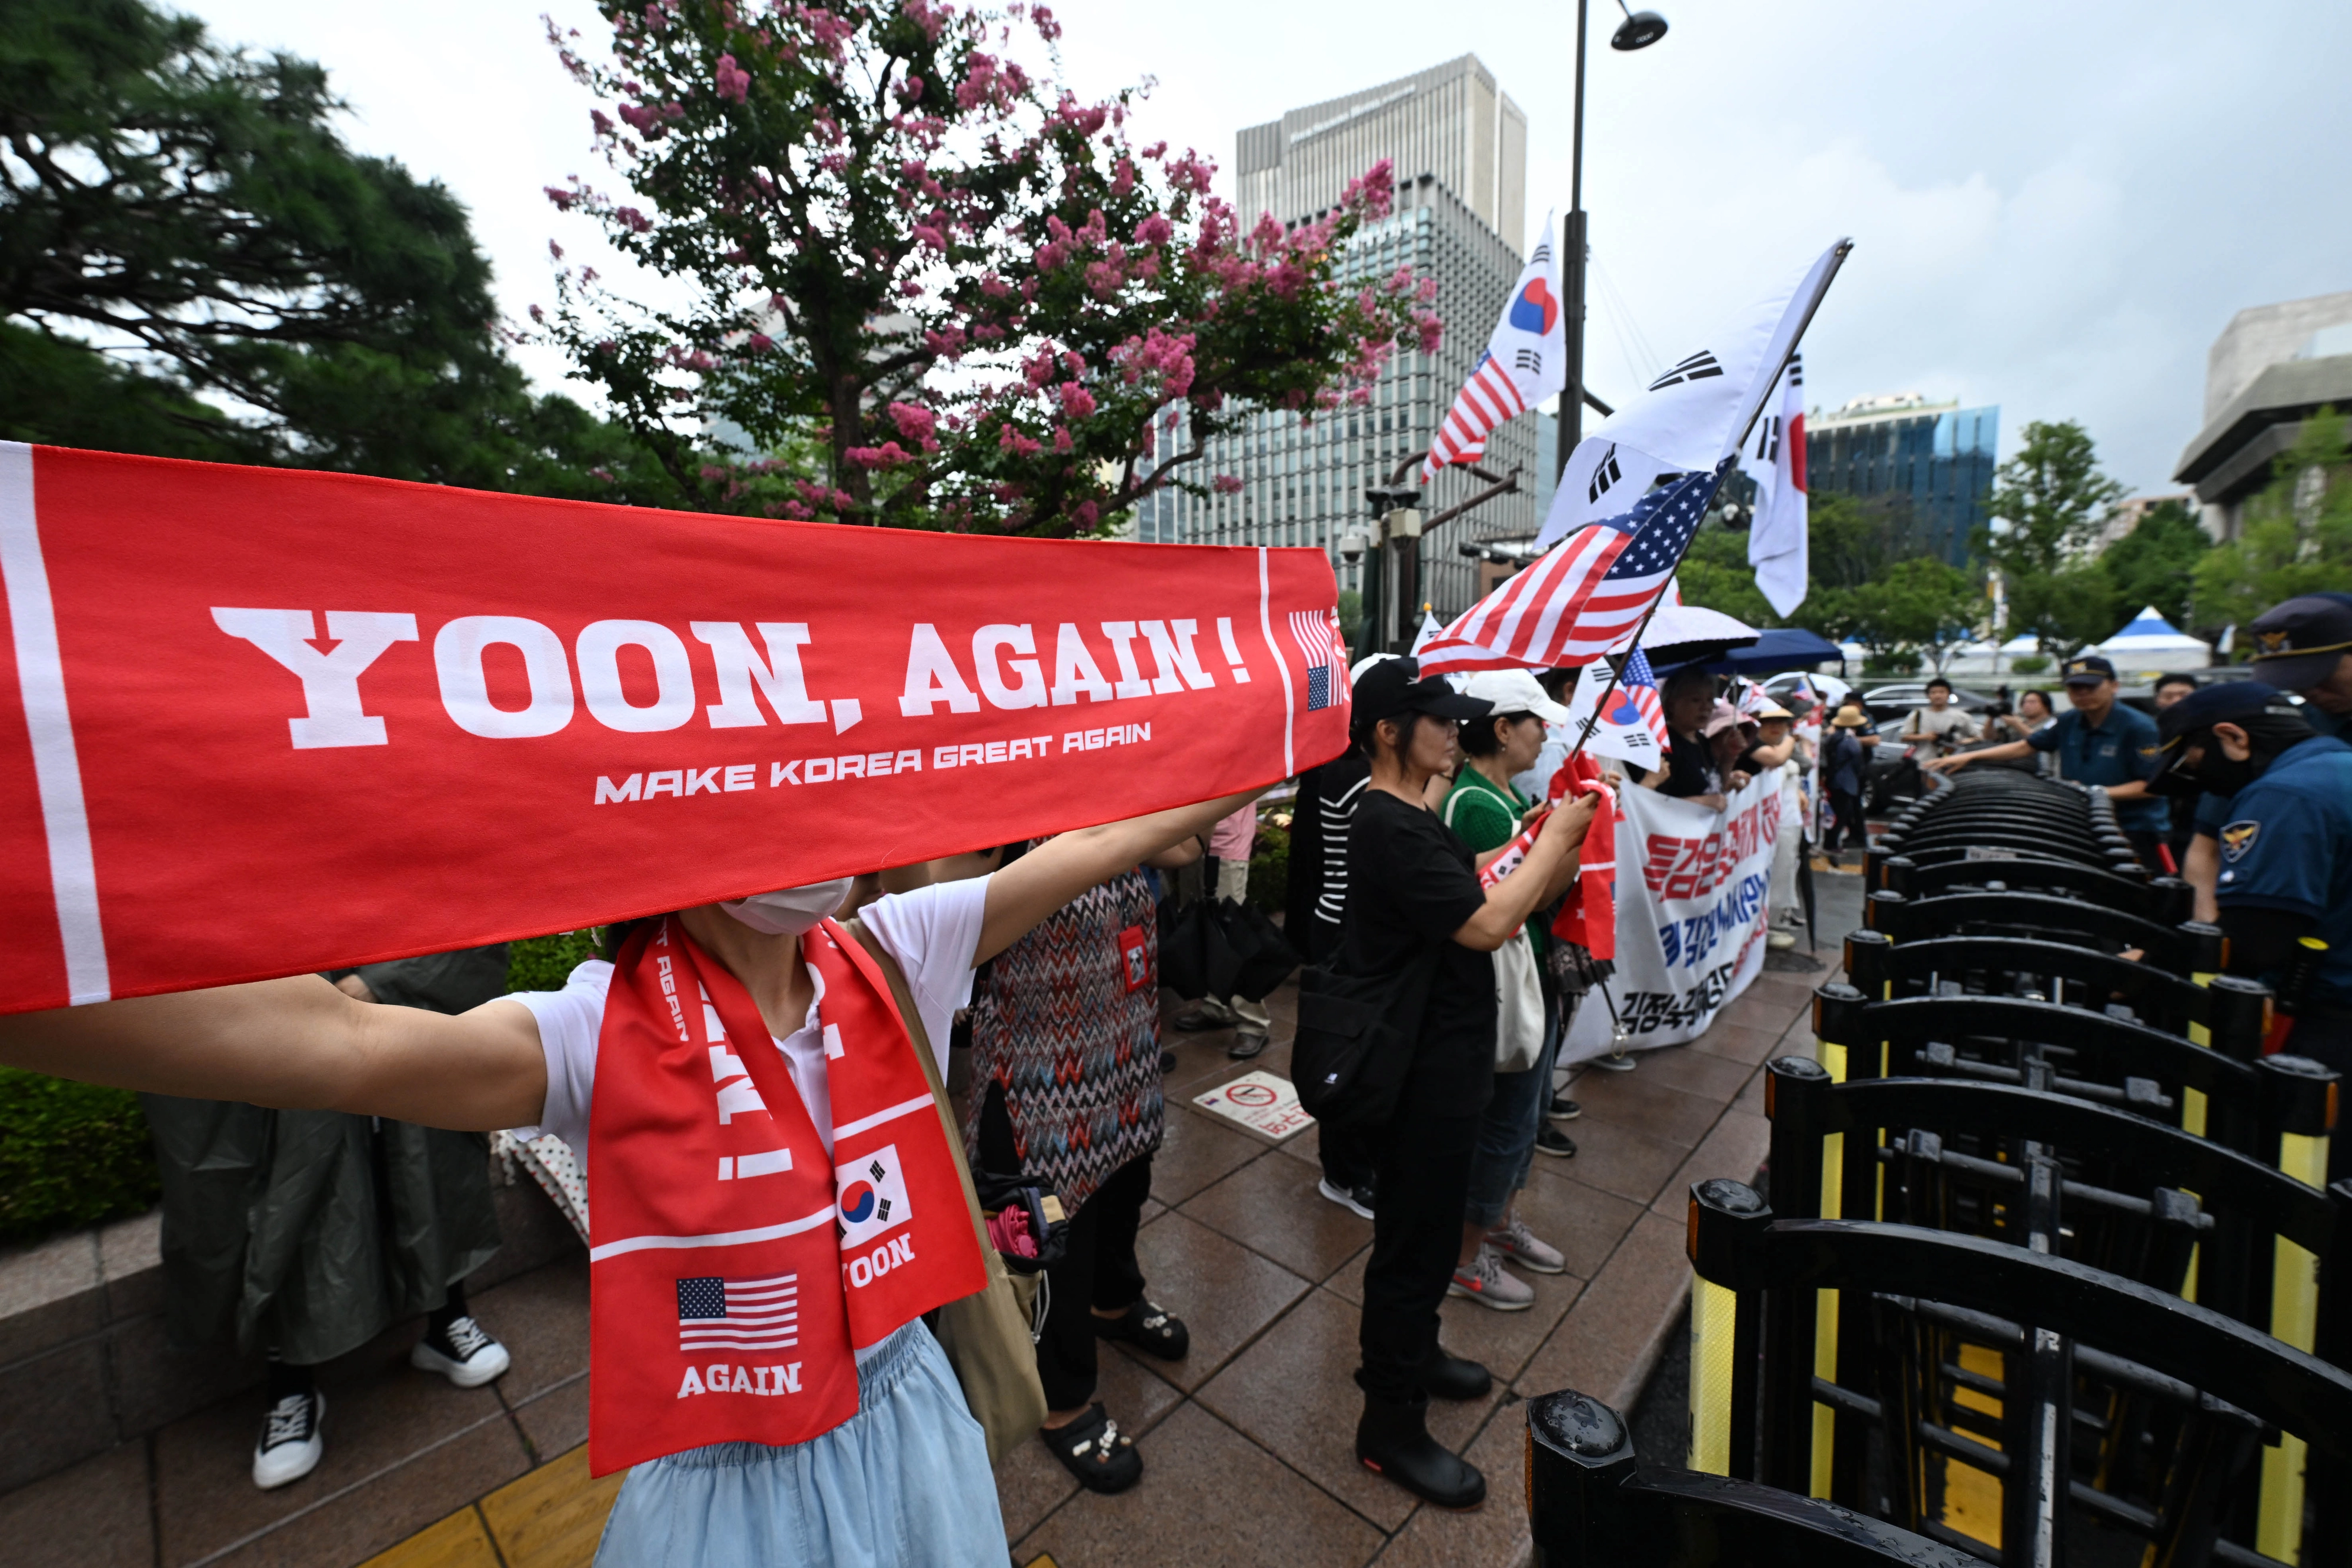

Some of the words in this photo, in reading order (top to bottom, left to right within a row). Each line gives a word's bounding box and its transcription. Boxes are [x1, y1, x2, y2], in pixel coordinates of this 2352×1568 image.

[210, 606, 863, 750] YOON,
[594, 764, 756, 805] MAKE
[770, 748, 922, 788] KOREA
[933, 735, 1053, 769] GREAT
[1062, 721, 1151, 754] AGAIN
[677, 1362, 803, 1399] AGAIN
